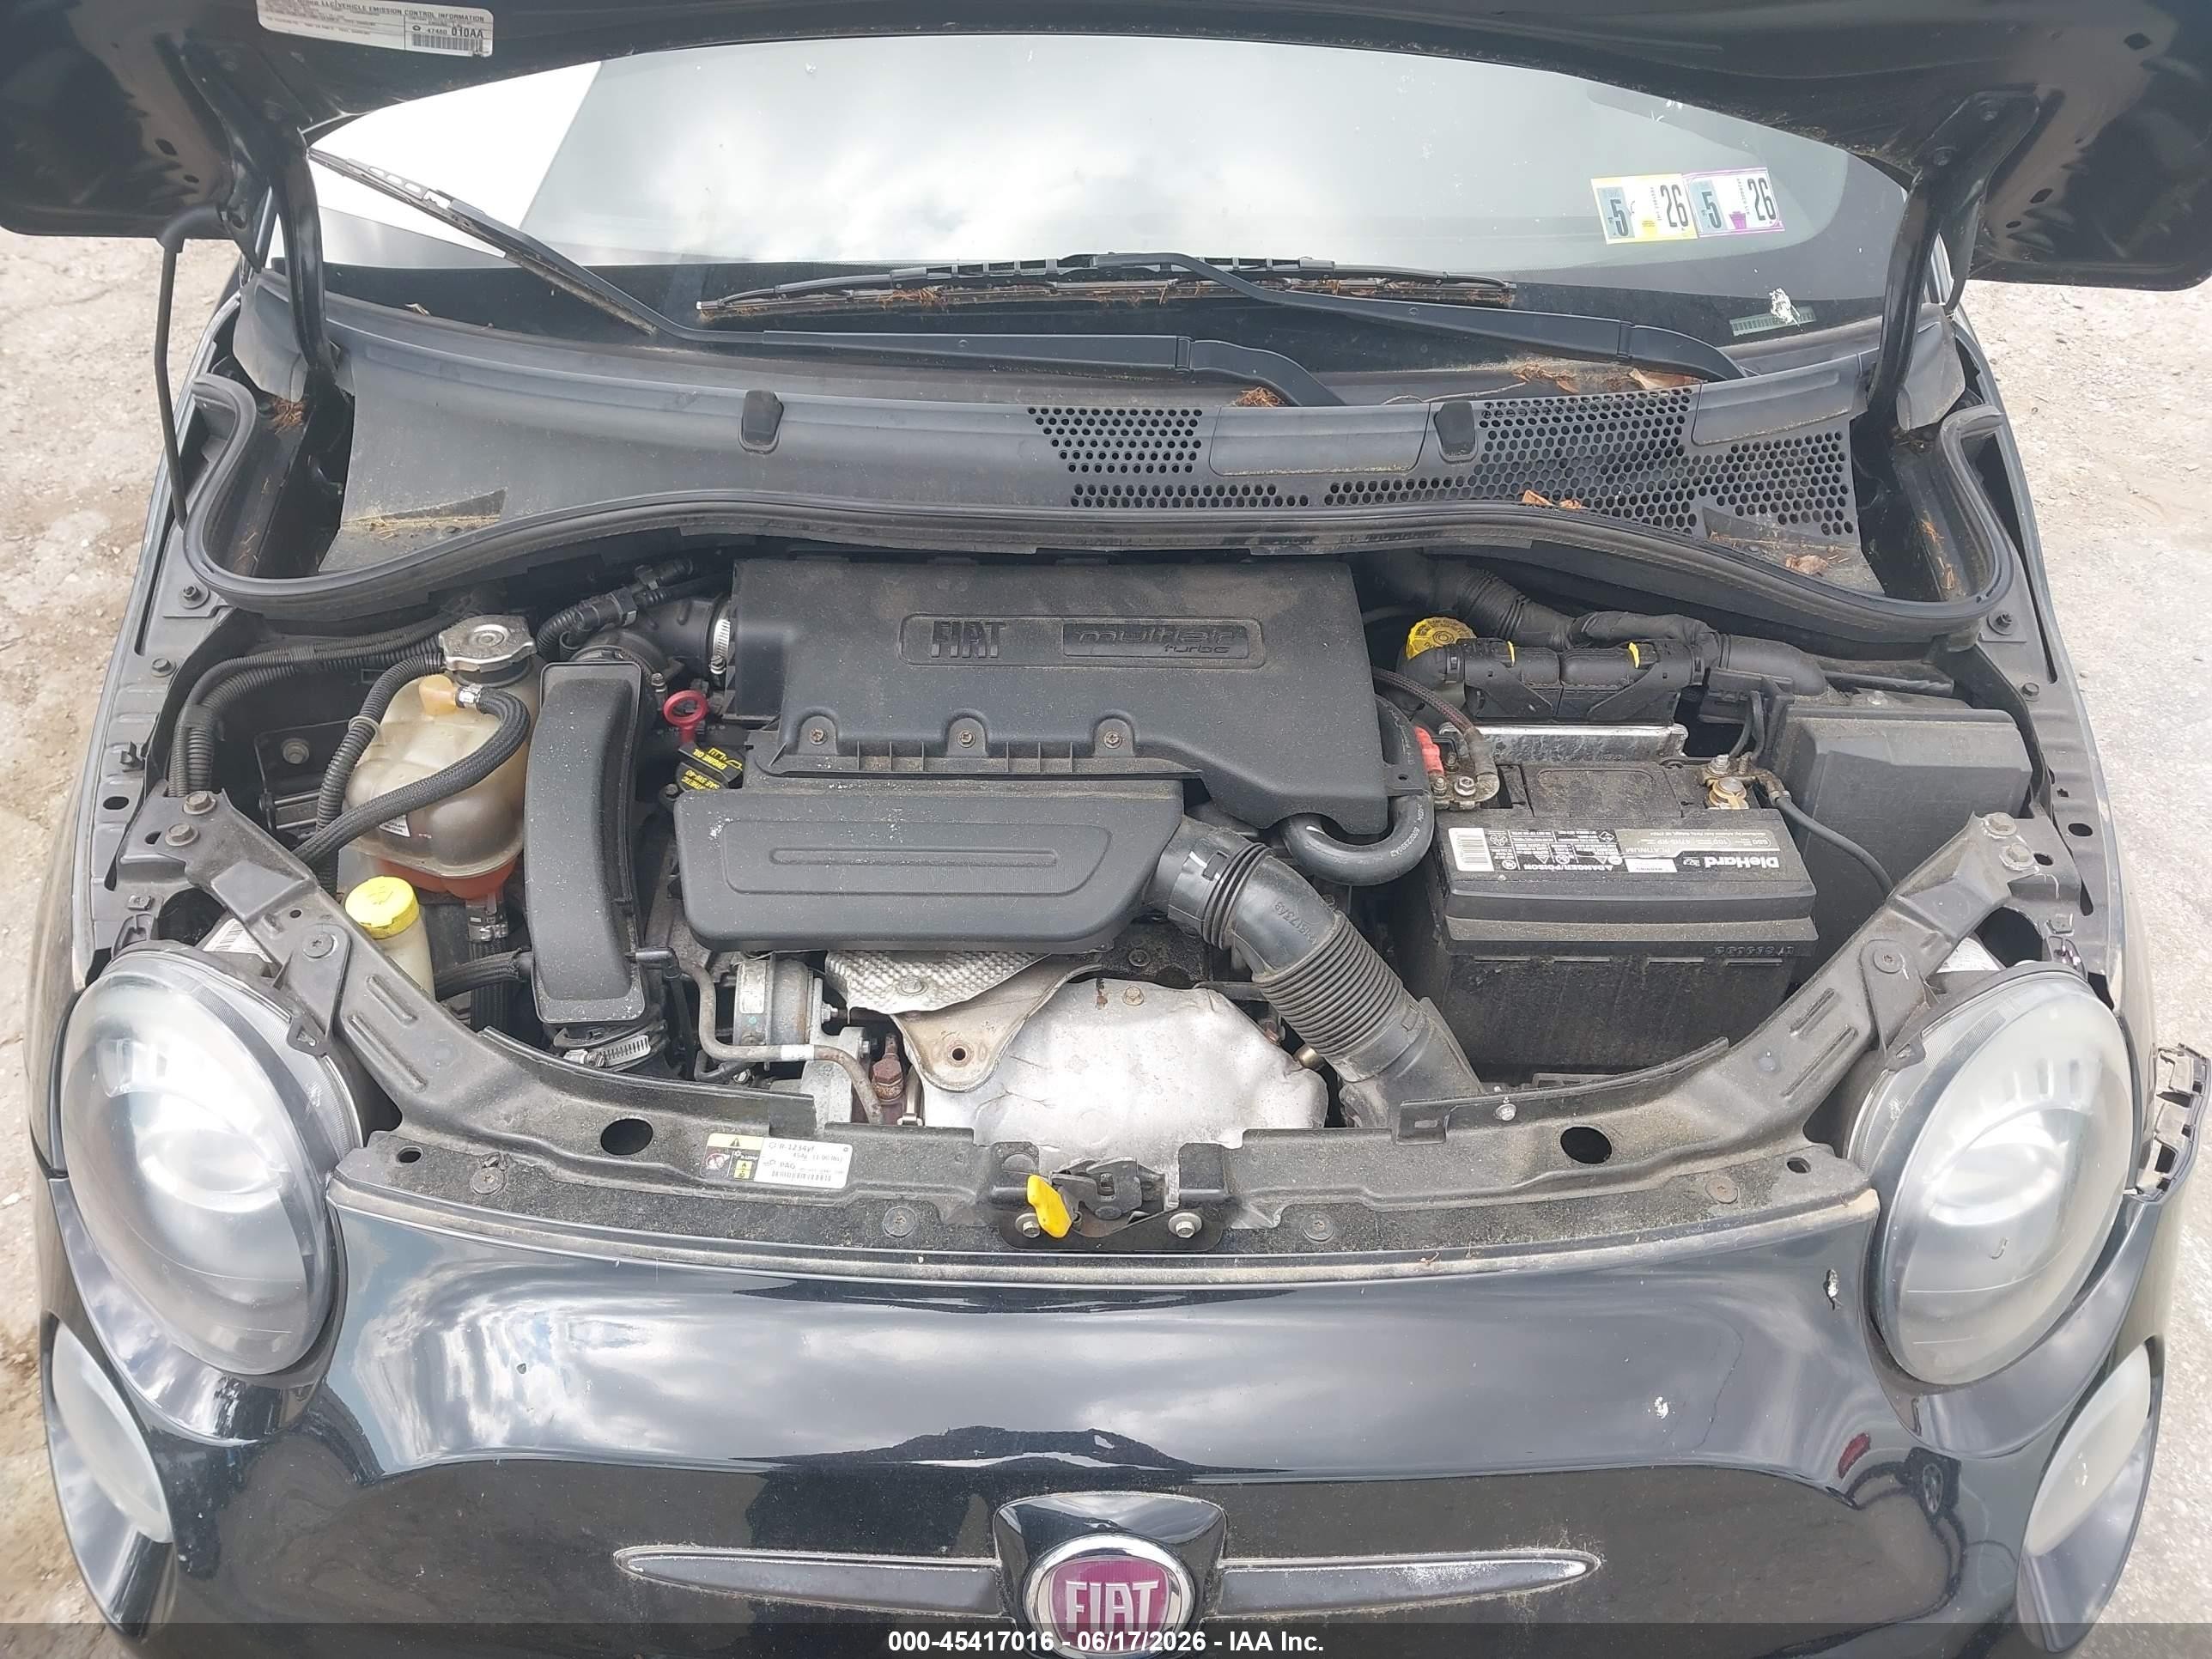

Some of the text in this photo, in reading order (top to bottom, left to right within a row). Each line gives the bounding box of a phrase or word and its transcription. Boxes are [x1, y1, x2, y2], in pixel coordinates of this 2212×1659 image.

[368, 6, 402, 15] EMISSION
[404, 9, 435, 18] CONTROL
[438, 13, 484, 21] INFORMATION
[451, 27, 483, 38] 010AA
[1610, 198, 1629, 236] 5
[1660, 184, 1689, 227] 26
[1701, 191, 1722, 228] 5
[1747, 177, 1777, 221] 26
[931, 621, 1233, 659] FIAT multiair
[1163, 642, 1231, 654] turbo
[1704, 856, 1779, 869] DieHard
[1065, 1579, 1159, 1632] FIAT
